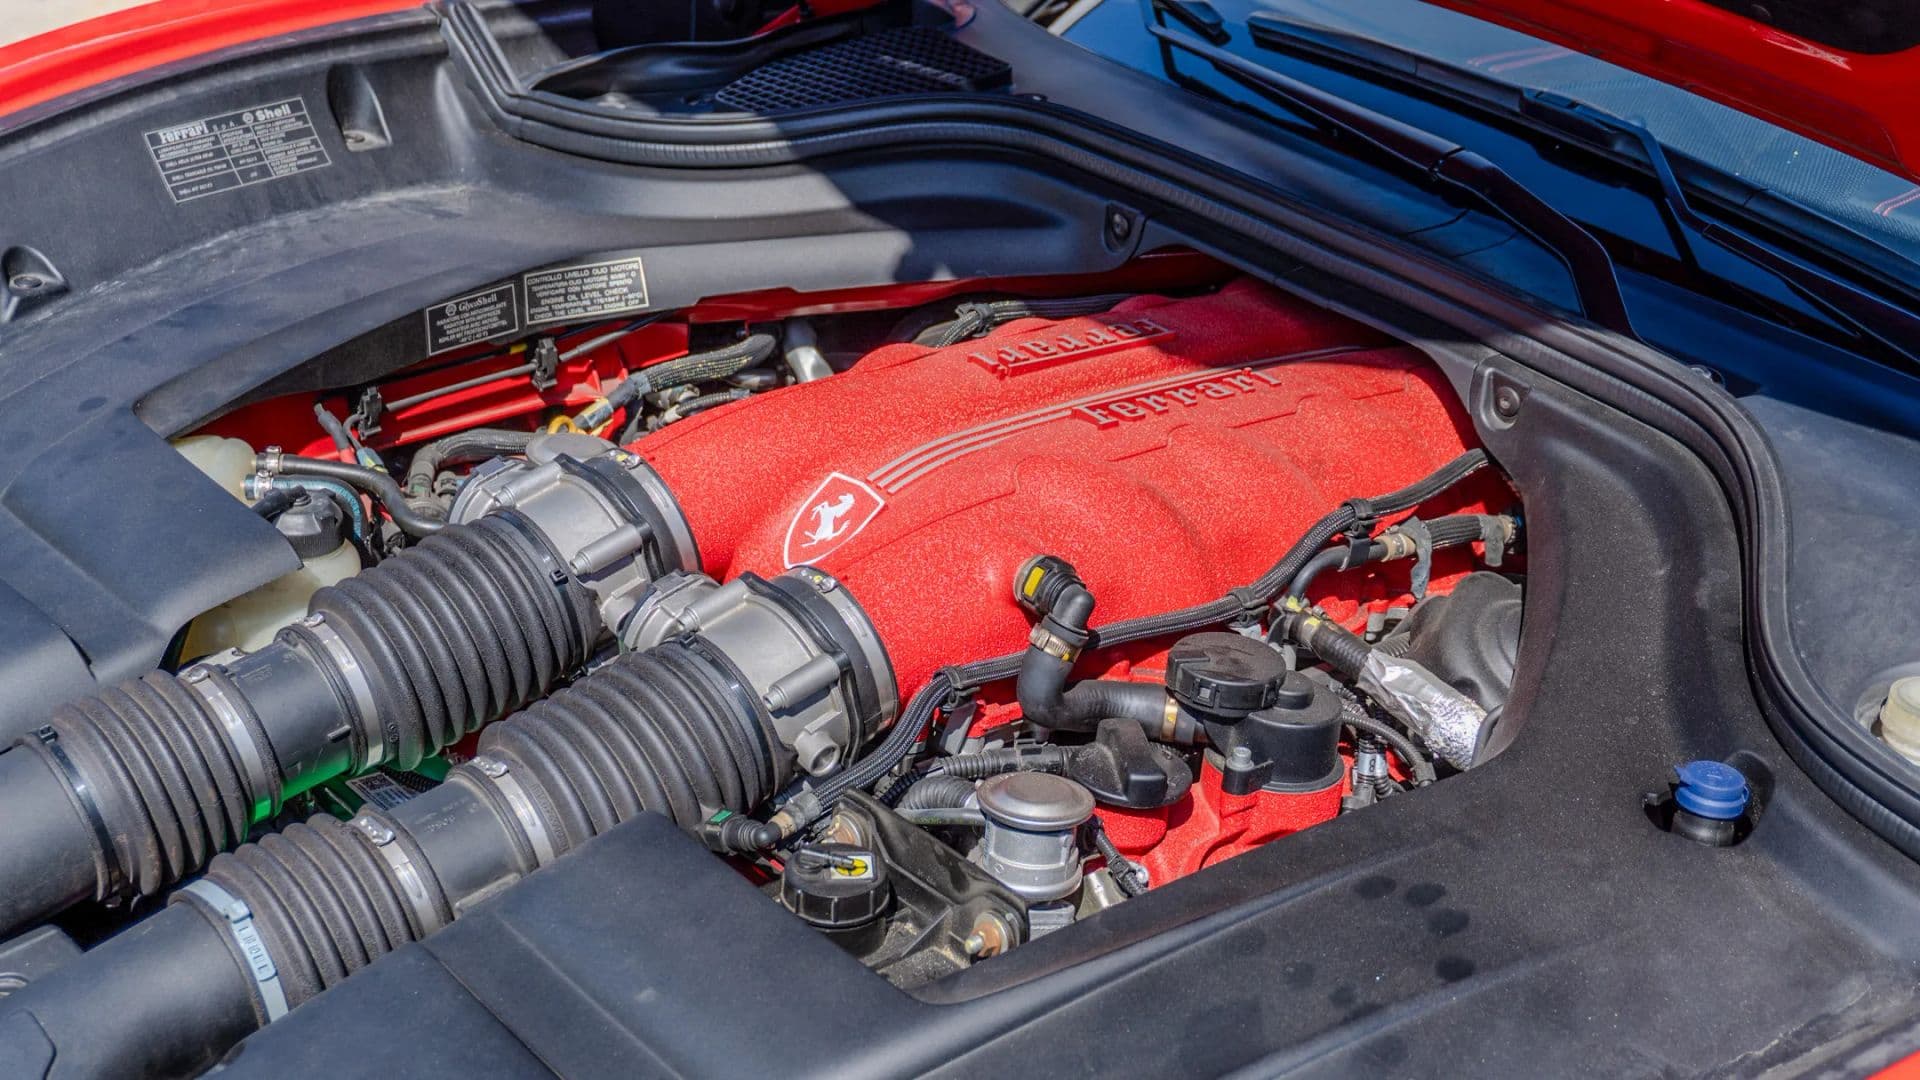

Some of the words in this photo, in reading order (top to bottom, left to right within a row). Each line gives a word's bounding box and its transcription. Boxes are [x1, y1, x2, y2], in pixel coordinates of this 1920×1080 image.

[255, 104, 291, 121] Shell
[158, 120, 209, 144] Ferrari
[527, 274, 562, 285] CONTROLLO
[564, 270, 589, 279] LIVELLO
[610, 262, 639, 271] MOTORE
[531, 282, 567, 291] TEMPERATURA
[583, 275, 608, 283] MOTORE
[582, 282, 607, 291] MOTORE
[540, 297, 564, 305] ENGINE
[580, 291, 601, 299] LEVEL
[604, 287, 628, 295] CHECK
[551, 300, 590, 310] TEMPERATURE
[603, 301, 625, 309] ENGINE
[967, 319, 1175, 380] Ferrari
[1072, 366, 1283, 430] Ferrari
